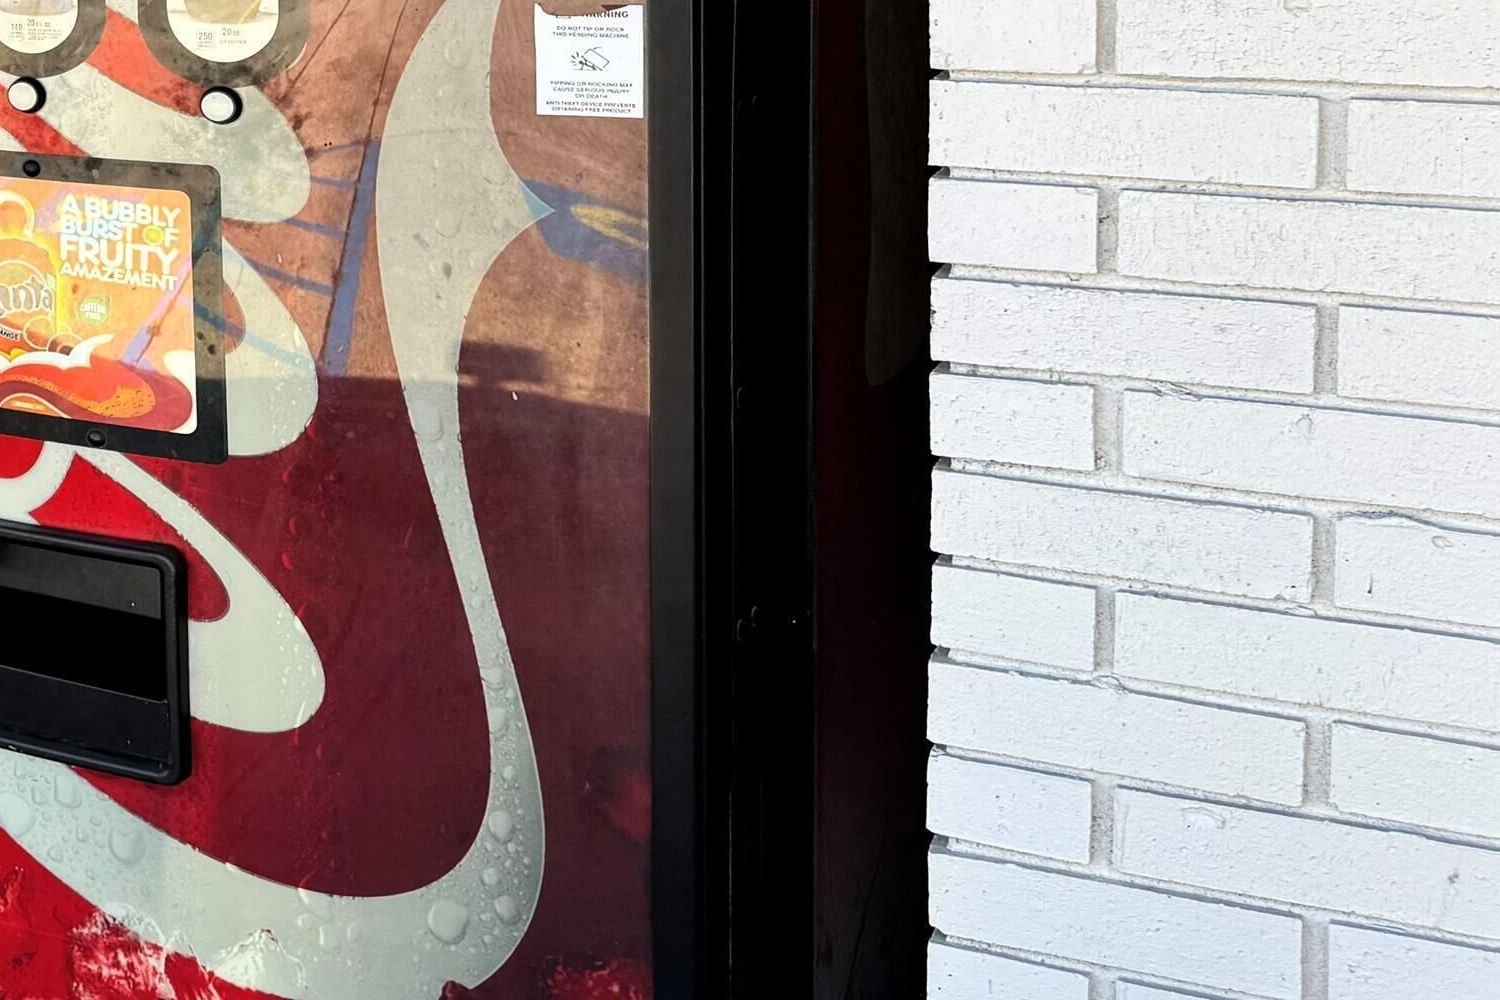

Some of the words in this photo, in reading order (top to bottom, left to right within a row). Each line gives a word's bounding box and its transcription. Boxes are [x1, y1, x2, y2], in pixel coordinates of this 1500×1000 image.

[197, 31, 213, 40] 250
[59, 192, 82, 215] A
[84, 195, 181, 227] BUBBLY
[59, 215, 139, 243] BURST
[142, 224, 181, 248] OF
[59, 233, 180, 275] FRUITY
[59, 260, 179, 292] AMAZEMENT
